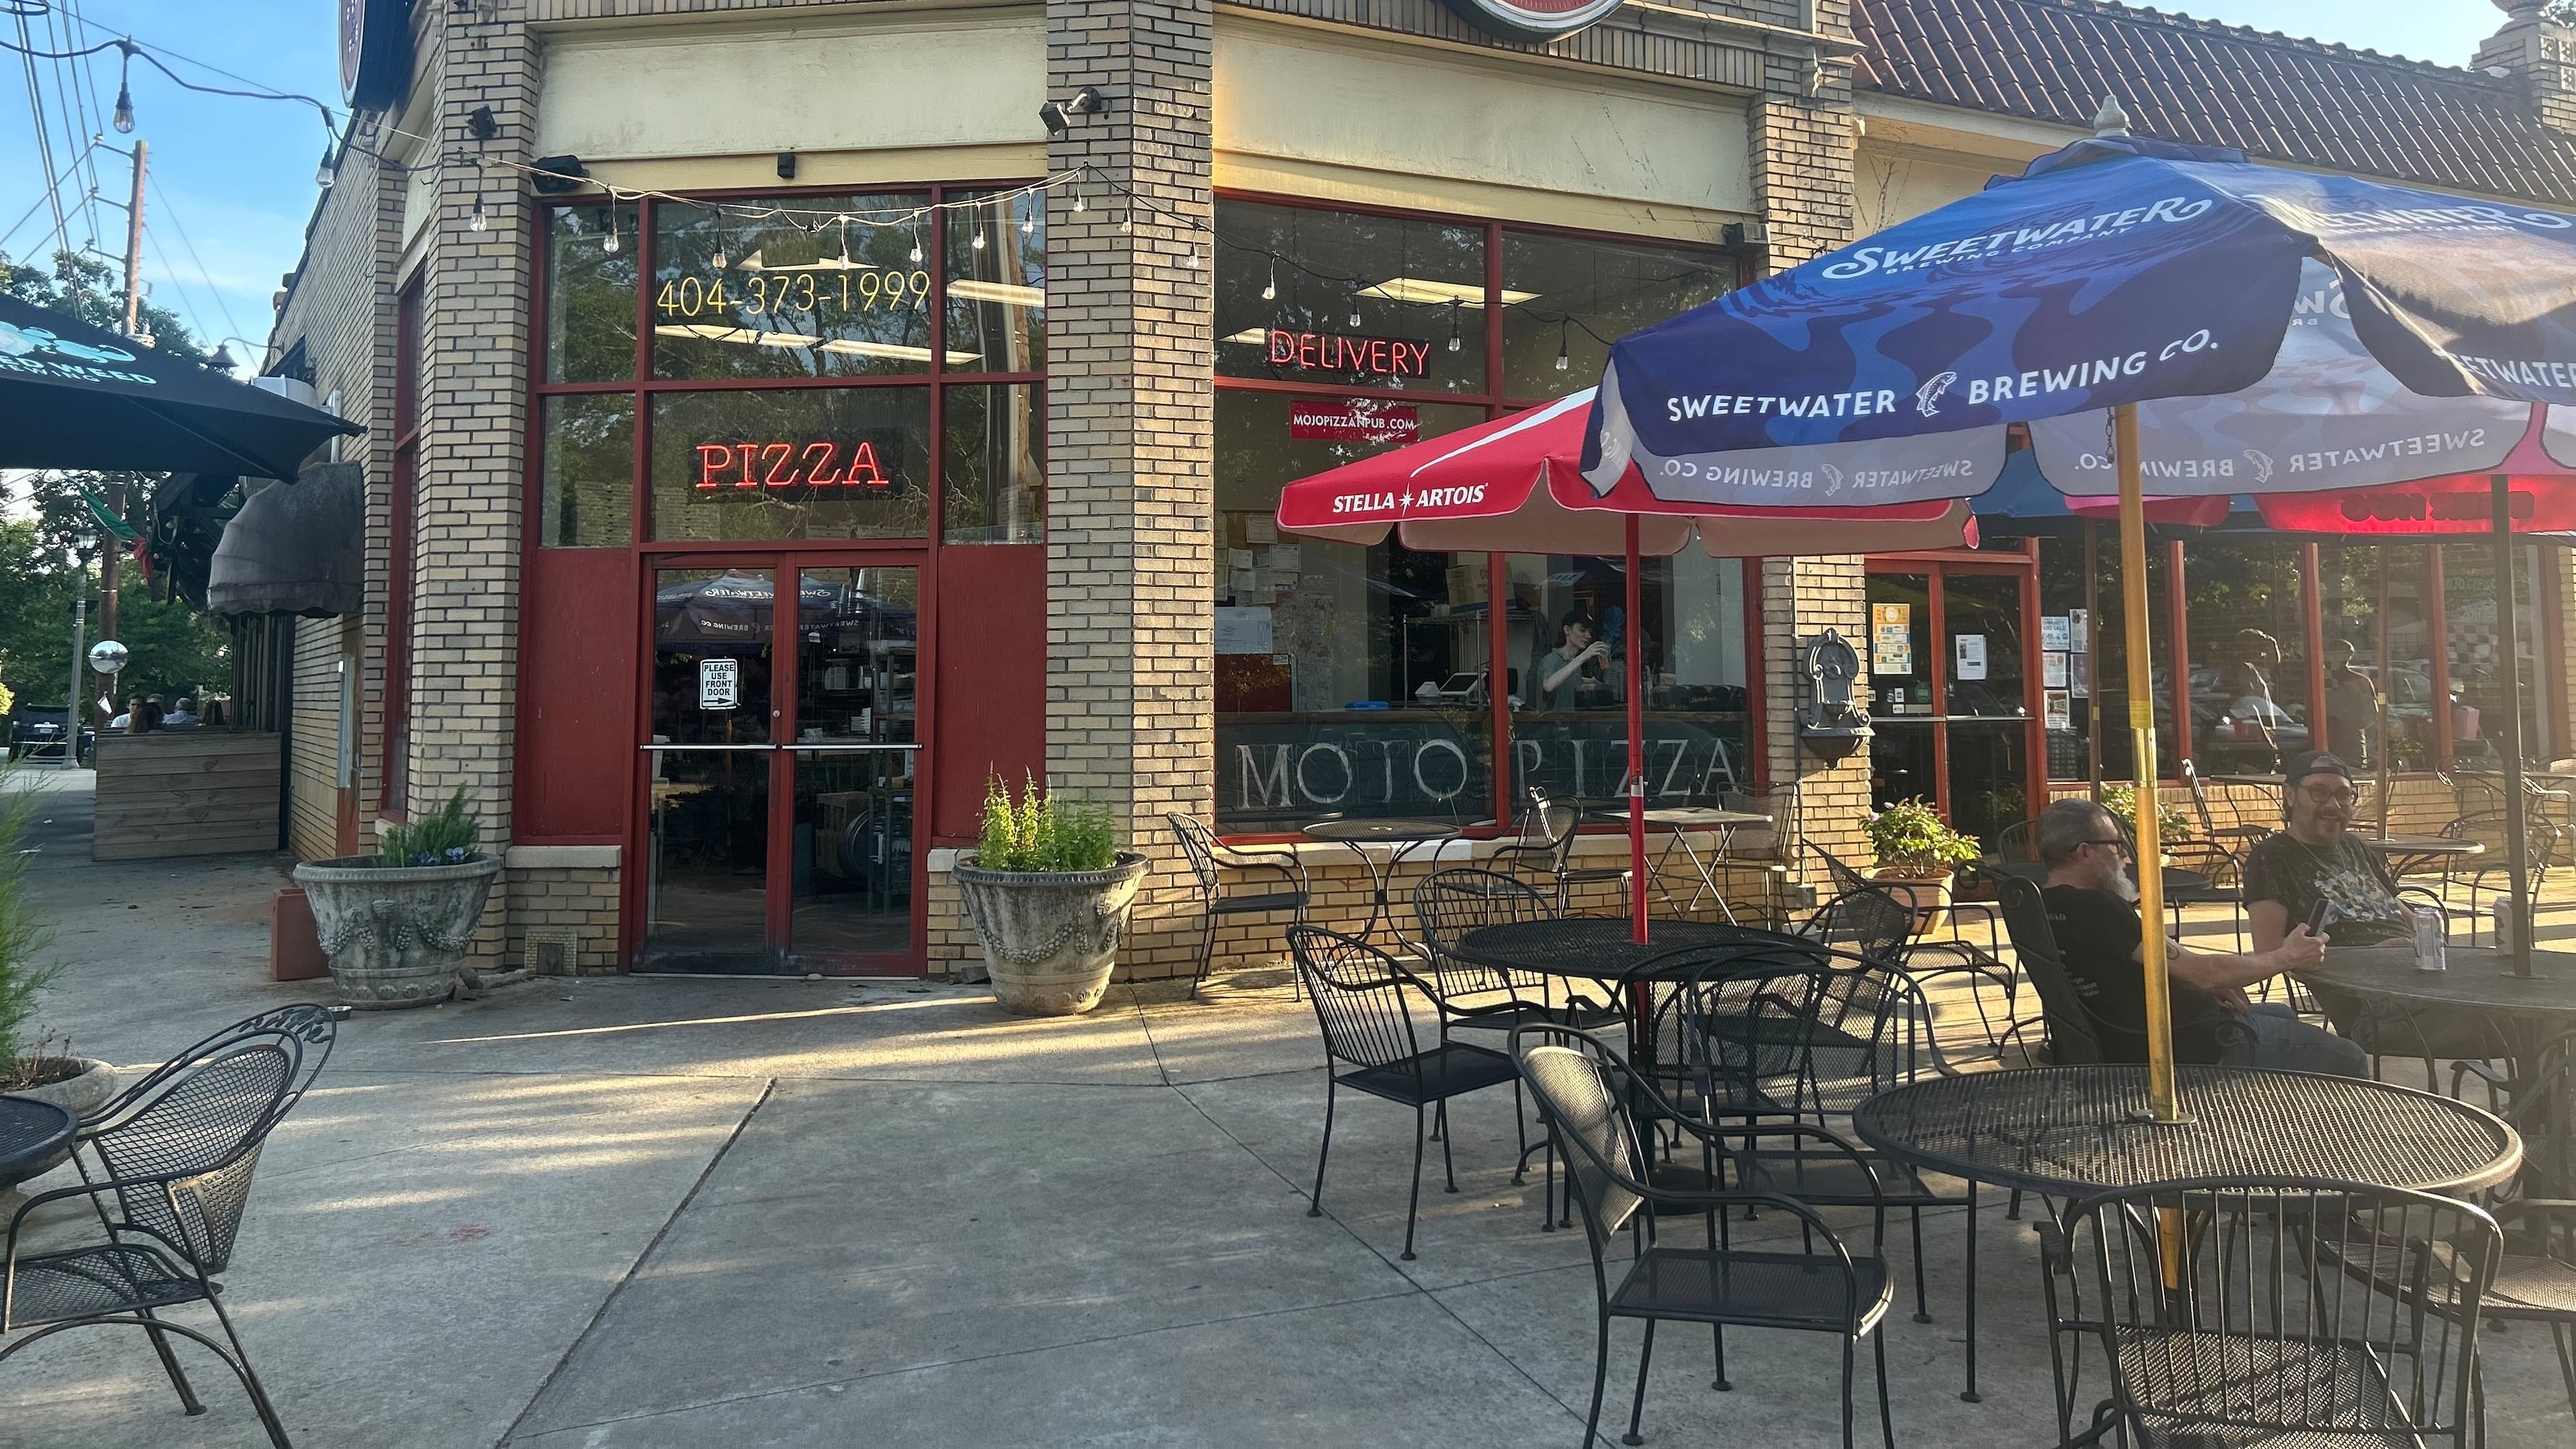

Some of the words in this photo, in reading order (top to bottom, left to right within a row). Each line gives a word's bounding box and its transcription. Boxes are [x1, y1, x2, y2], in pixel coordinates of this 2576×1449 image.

[1821, 197, 2212, 279] SWEETWATER
[1886, 250, 1999, 275] BREWING
[2011, 225, 2134, 254] COMPANY
[657, 270, 930, 317] 404-373-1999
[48, 362, 157, 384] WEED
[1271, 329, 1430, 376] DELIVERY
[1668, 389, 1896, 422] SWEETWATER
[1968, 351, 2147, 405] BREWING
[2159, 329, 2219, 363] CO.
[696, 441, 890, 488] PIZZA
[1332, 492, 1395, 513] STELLA
[1415, 484, 1485, 508] ARTOIS
[1237, 739, 1467, 808] MOJO
[1514, 739, 1743, 798] PIZZA
